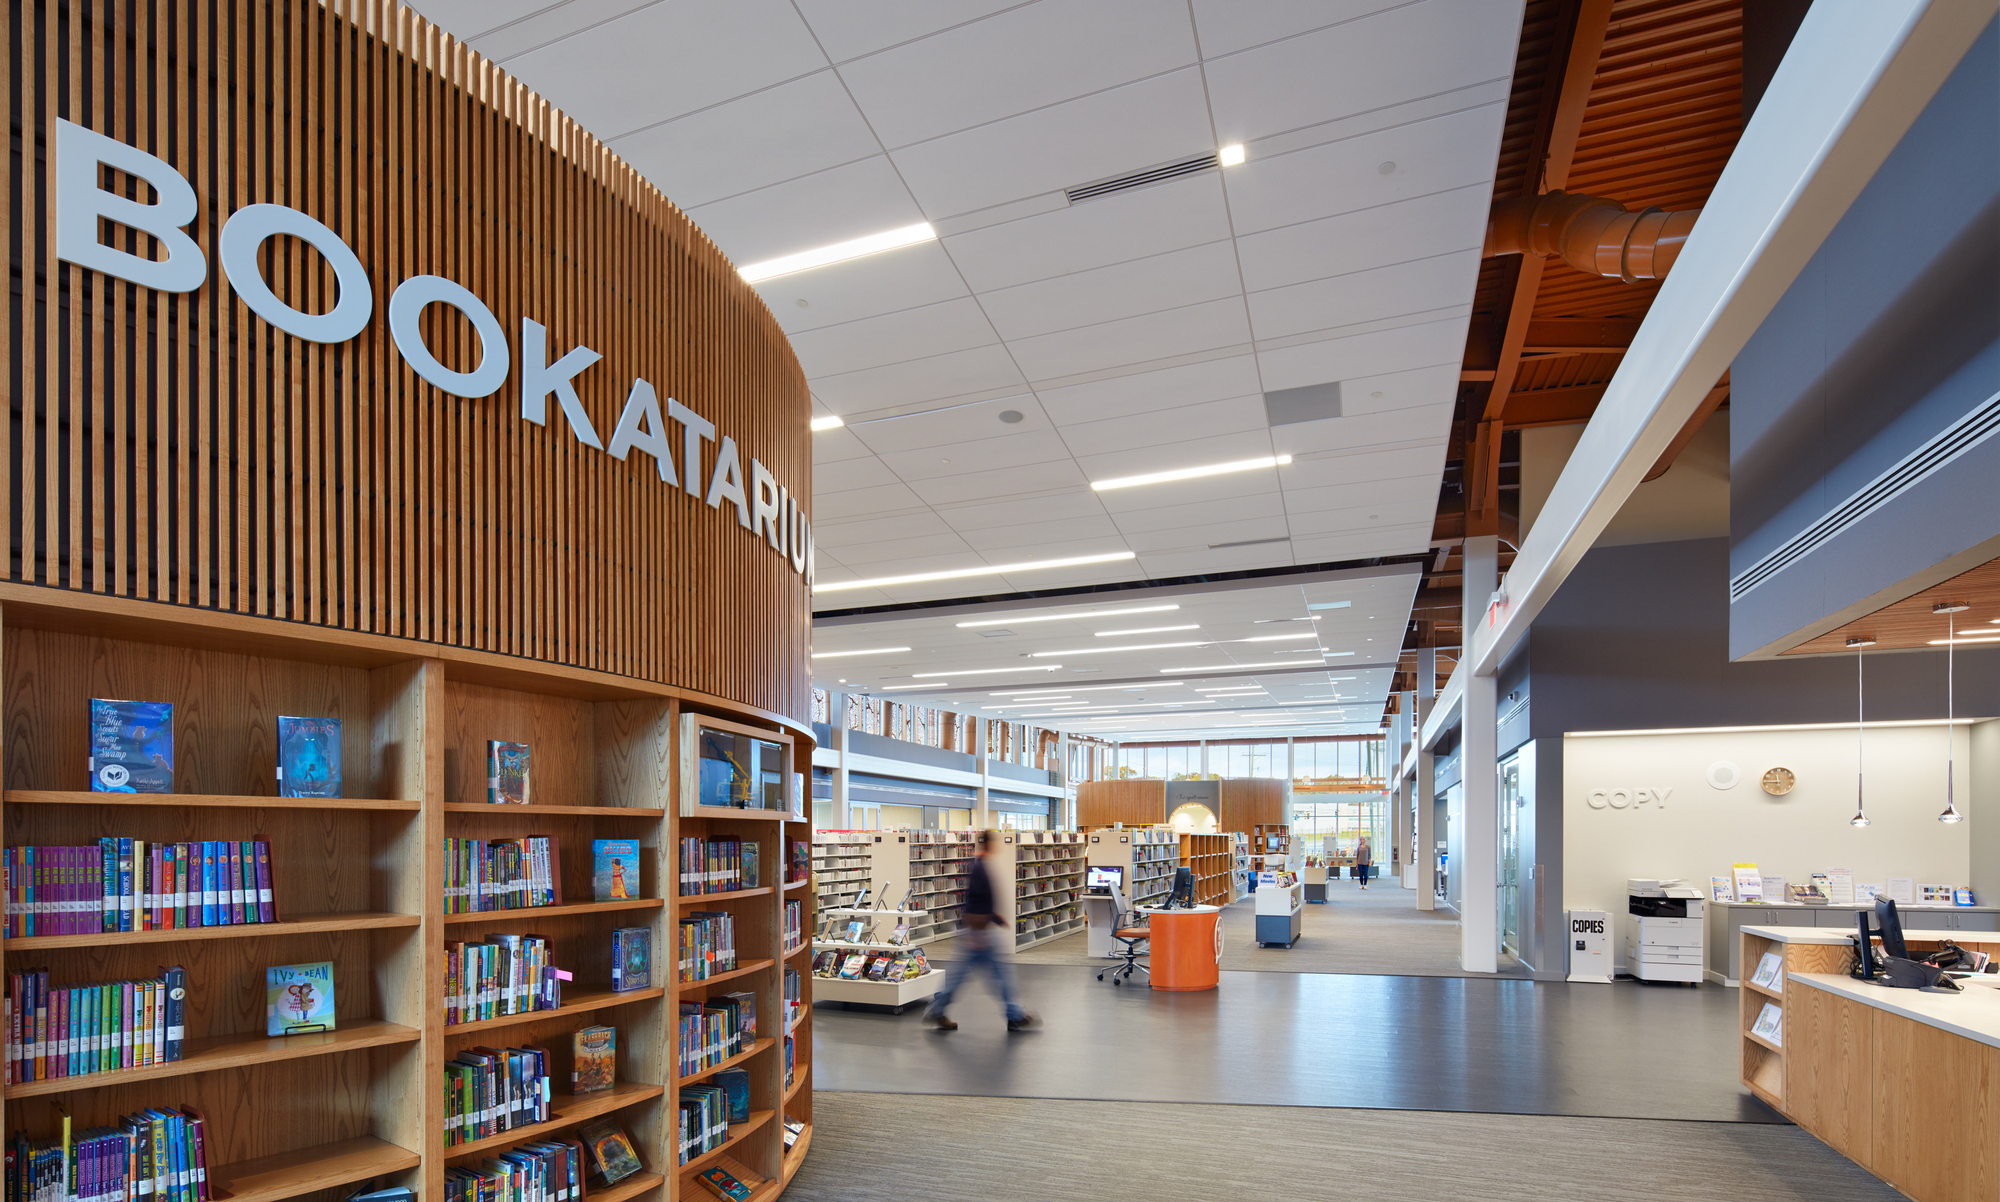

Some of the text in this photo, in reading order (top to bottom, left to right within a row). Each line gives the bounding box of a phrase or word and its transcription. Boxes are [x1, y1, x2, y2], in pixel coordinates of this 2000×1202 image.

[102, 705, 118, 716] True
[104, 715, 123, 726] Blue
[97, 723, 119, 733] Scouts
[287, 722, 335, 736] JUMBIES
[97, 732, 120, 745] Sugar
[99, 746, 127, 761] Swamp
[1587, 787, 1673, 810] COPY
[602, 846, 633, 855] SKIES
[104, 859, 115, 880] NIGHT
[1572, 919, 1604, 934] COPIES
[304, 965, 328, 981] BEAN
